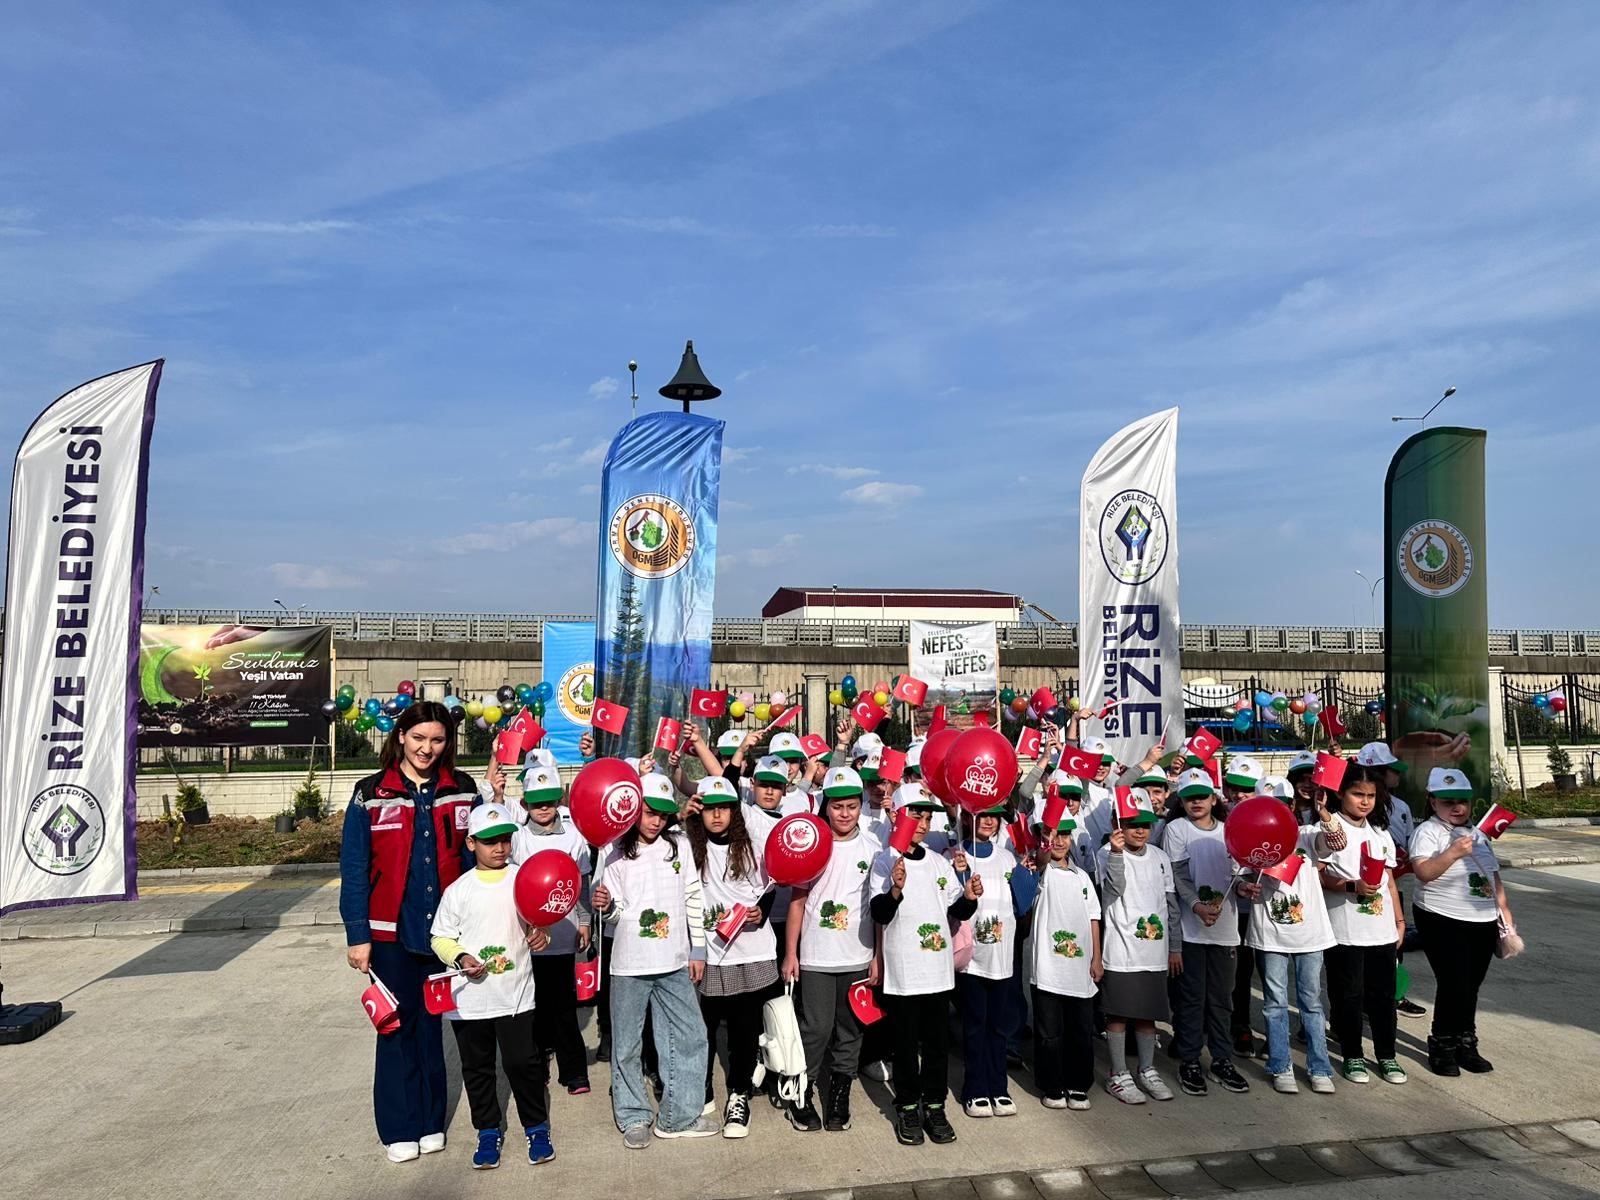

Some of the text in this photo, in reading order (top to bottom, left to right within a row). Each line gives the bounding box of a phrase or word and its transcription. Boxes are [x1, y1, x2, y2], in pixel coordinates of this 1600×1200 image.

[632, 550, 654, 566] OGM
[41, 424, 104, 771] RİZE BELEDİYESİ
[921, 634, 963, 655] NEFES
[239, 670, 304, 683] Yeşil Vatan
[945, 655, 986, 677] NEFES
